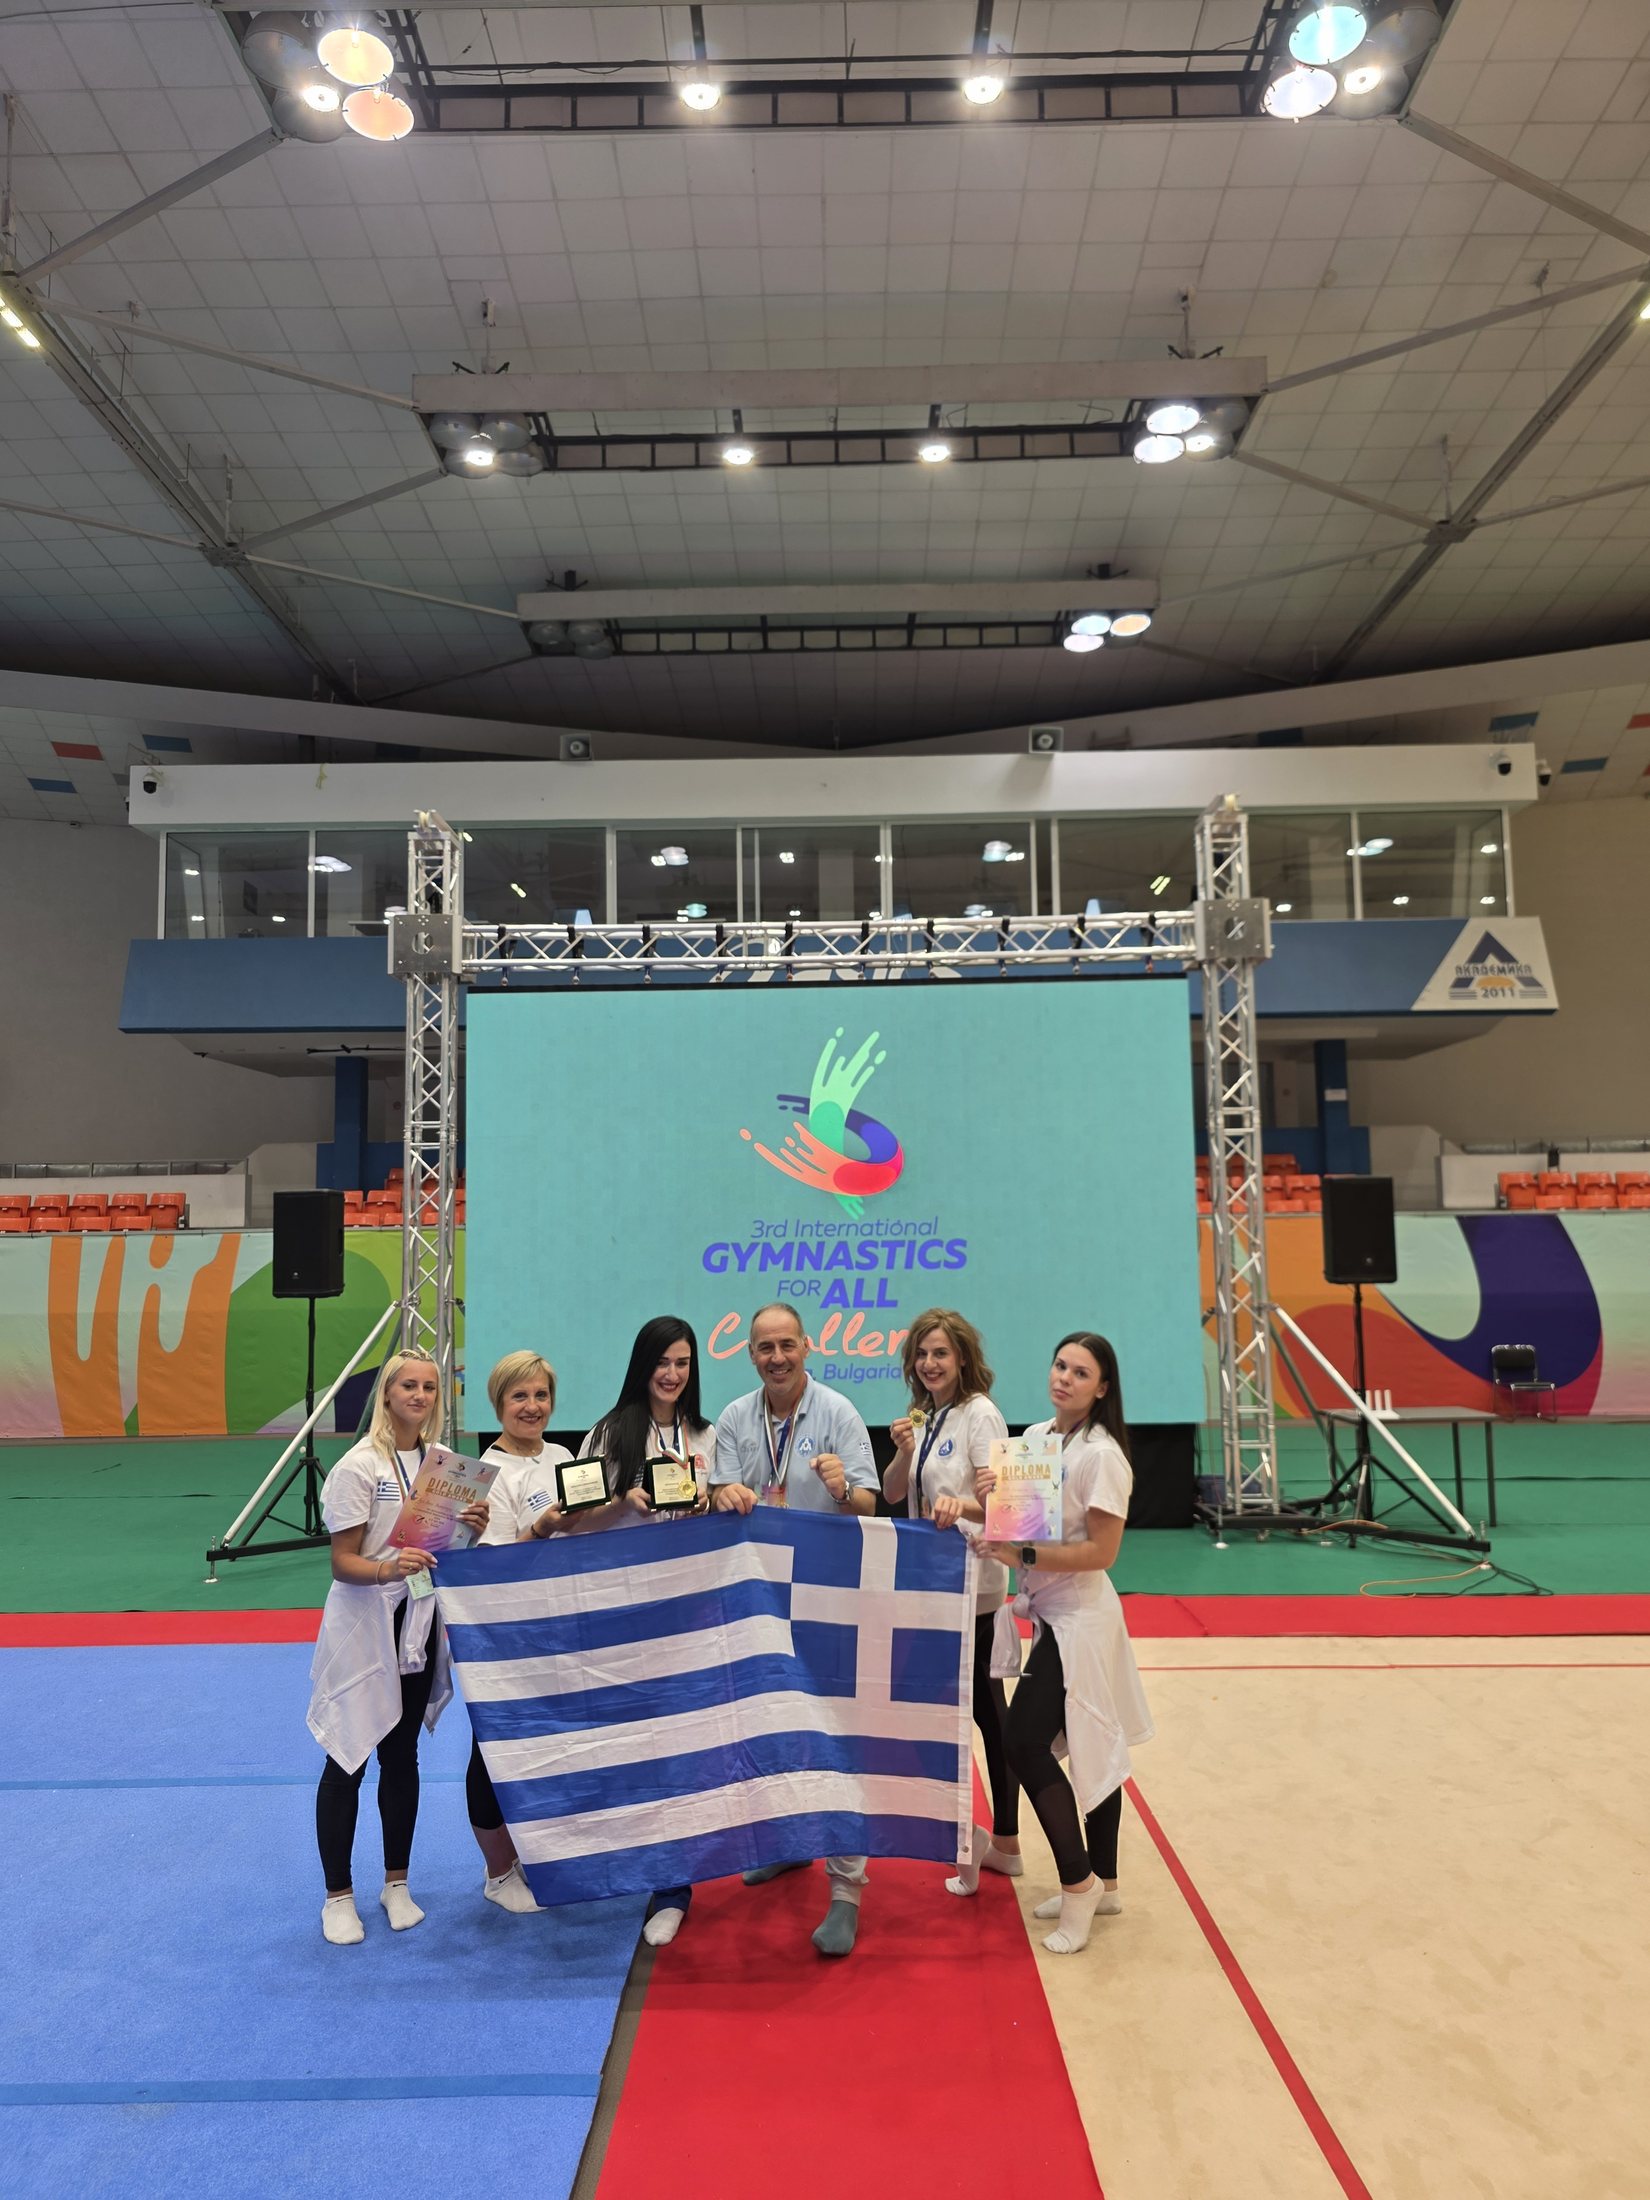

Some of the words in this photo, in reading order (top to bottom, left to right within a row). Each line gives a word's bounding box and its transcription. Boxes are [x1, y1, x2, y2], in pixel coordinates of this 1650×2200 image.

[1481, 988, 1515, 998] 2011
[750, 1219, 788, 1239] 3rd
[794, 1216, 939, 1238] International
[702, 1238, 968, 1273] GYMNASTICS
[777, 1280, 822, 1297] FOR
[819, 1278, 898, 1309] ALL
[1001, 1463, 1051, 1476] DIPLOMA
[428, 1477, 477, 1500] DIPLOMA
